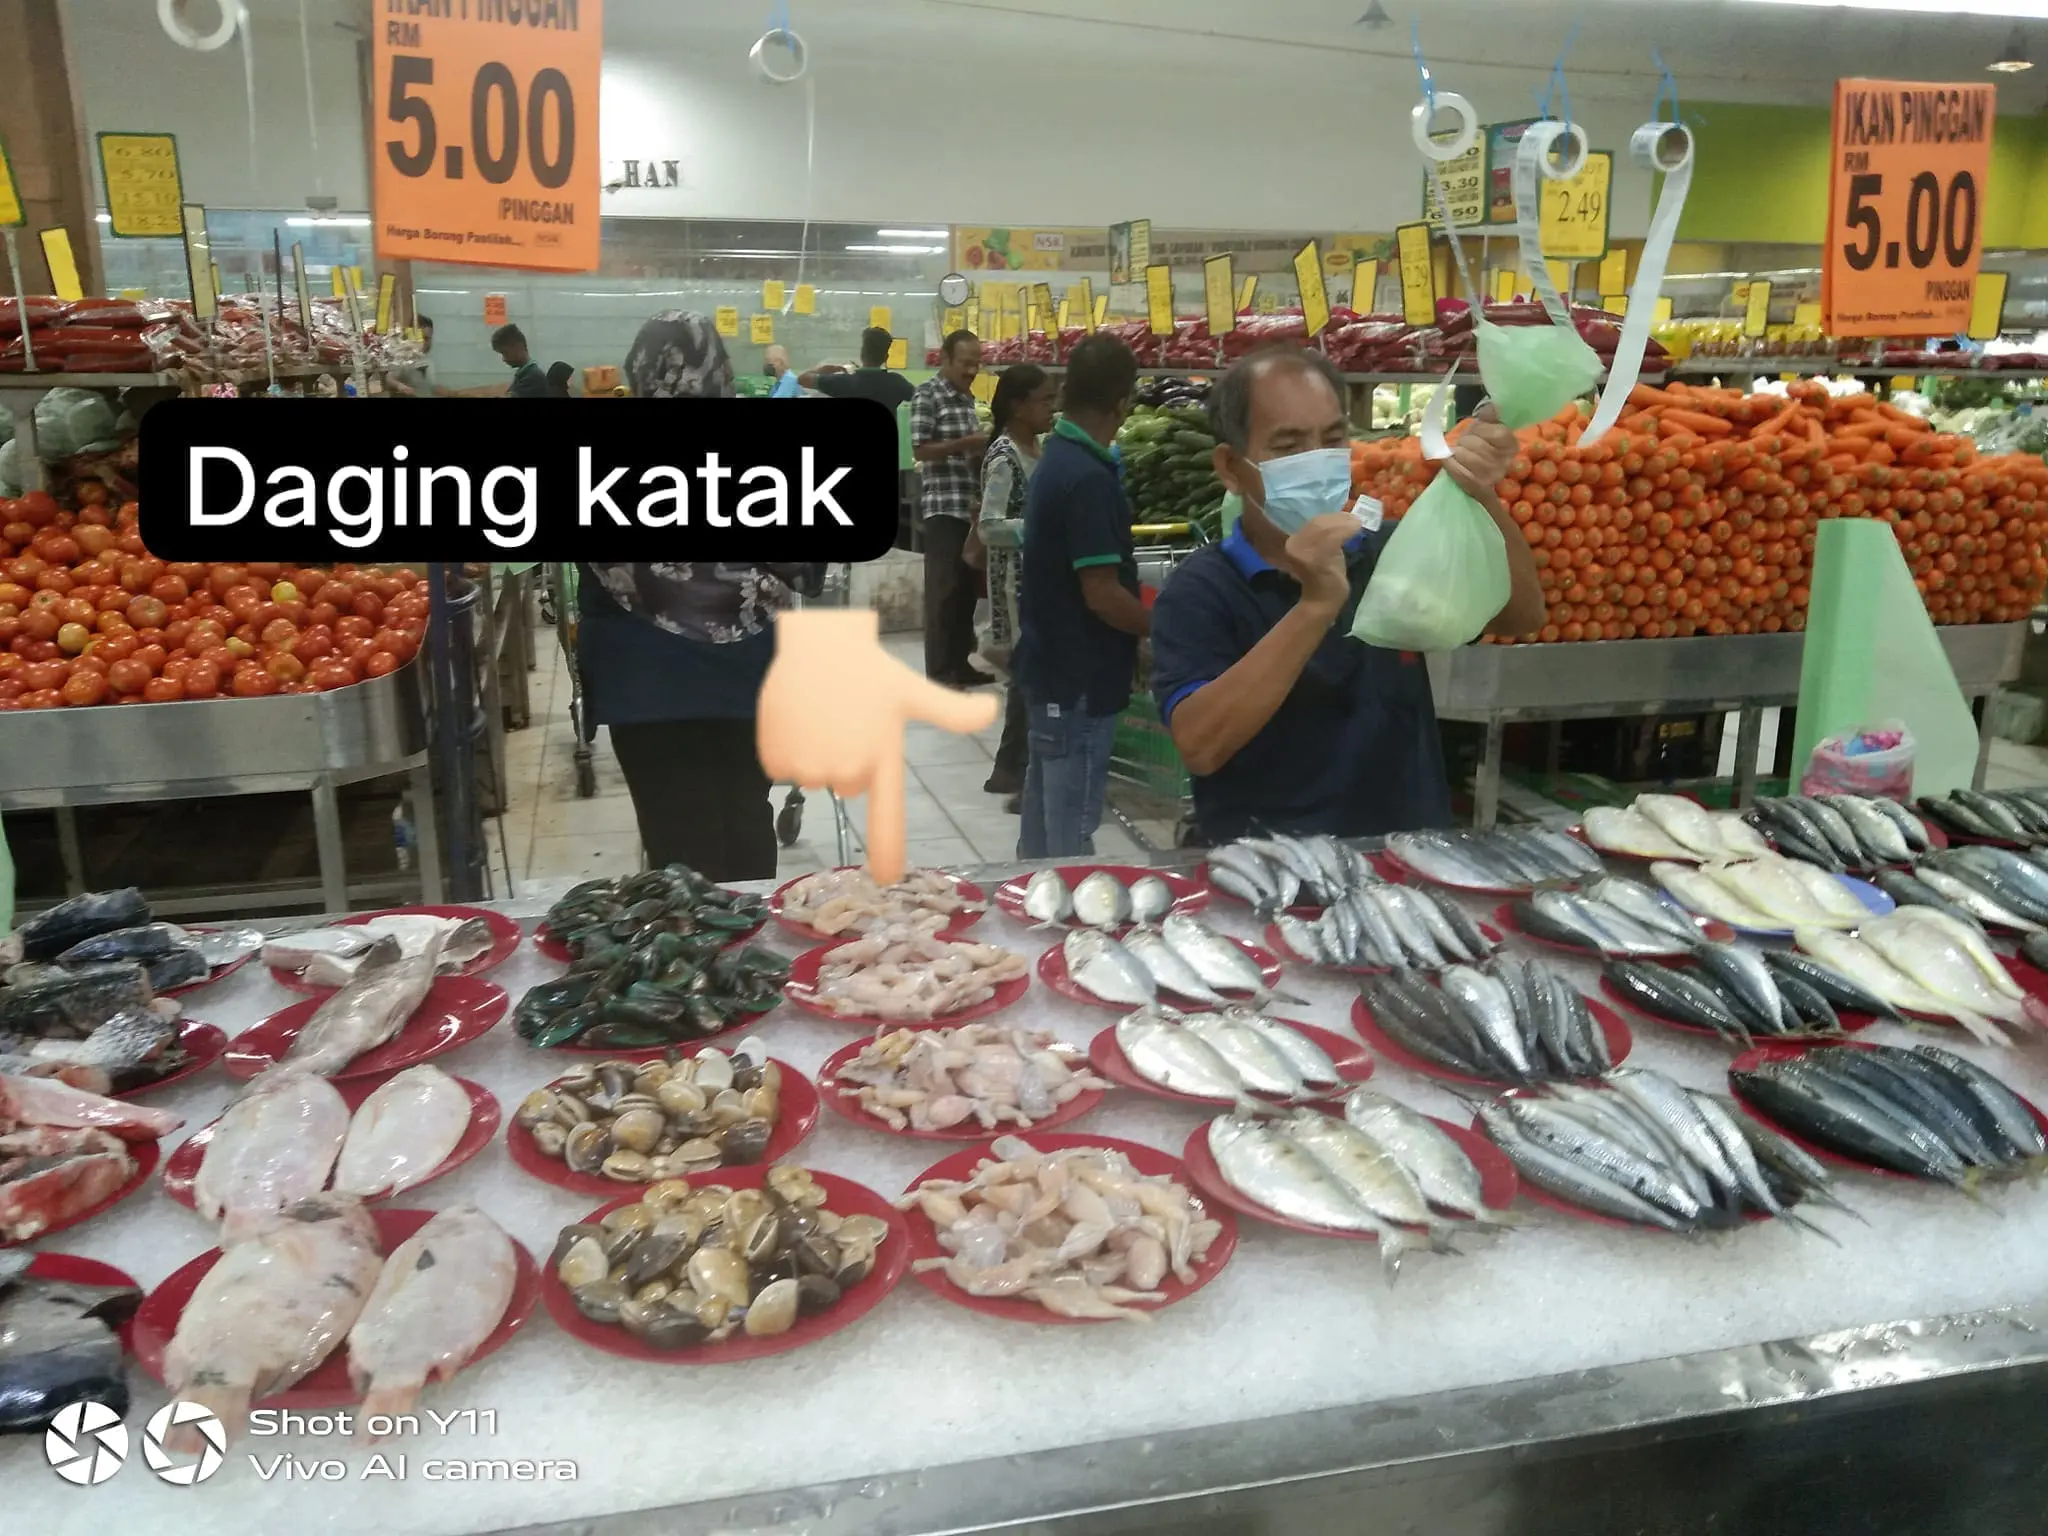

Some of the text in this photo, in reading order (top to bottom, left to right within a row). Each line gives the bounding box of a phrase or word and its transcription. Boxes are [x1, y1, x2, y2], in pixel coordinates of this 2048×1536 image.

[387, 20, 421, 47] RM
[386, 55, 576, 189] 5.00
[1843, 90, 1987, 146] IKAN PINGGAN
[1844, 152, 1869, 171] RM
[500, 197, 575, 225] PINGGAN
[1430, 206, 1478, 220] 650
[1557, 190, 1601, 224] 2.49
[1843, 170, 1977, 271] 5.00
[1925, 279, 1970, 301] PINGGAN
